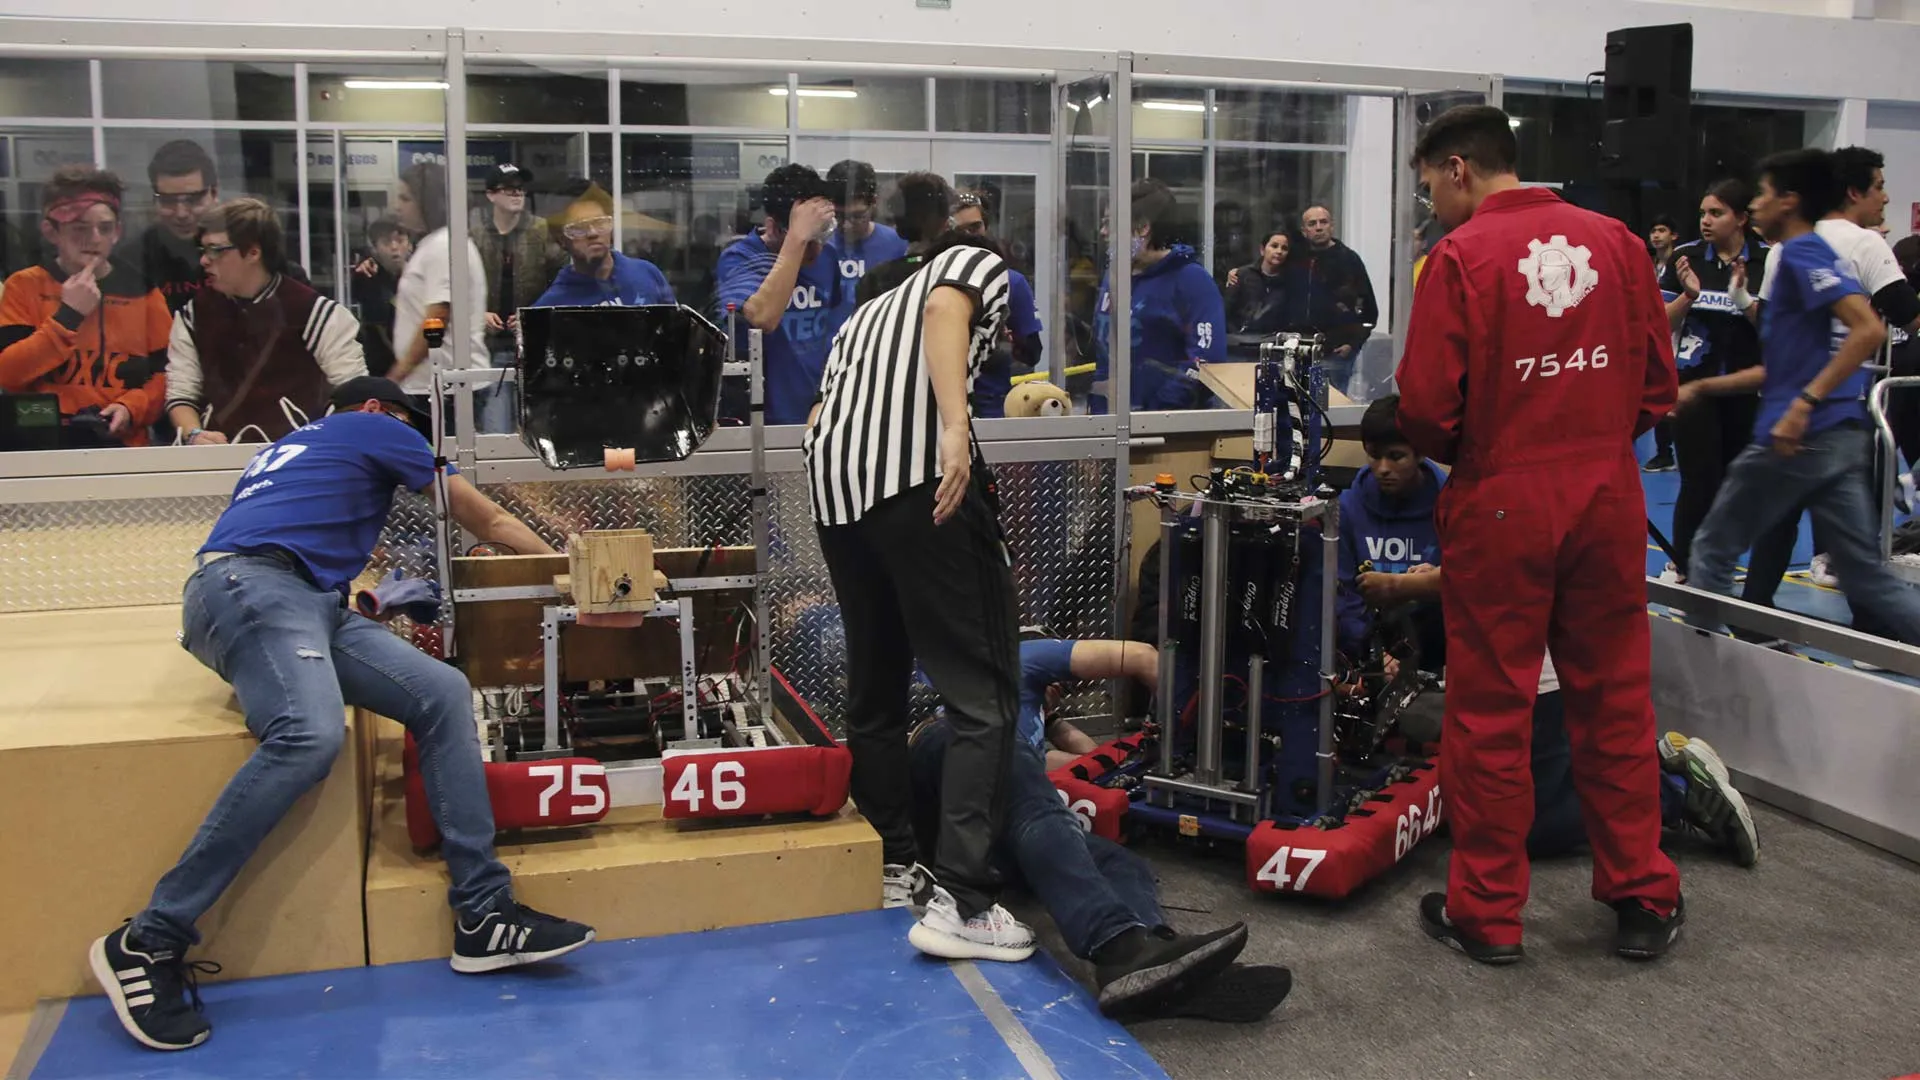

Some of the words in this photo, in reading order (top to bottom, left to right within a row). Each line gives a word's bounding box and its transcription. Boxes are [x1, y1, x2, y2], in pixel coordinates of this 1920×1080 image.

[1196, 322, 1213, 337] 66
[1197, 337, 1213, 349] 47
[1515, 344, 1609, 382] 7546
[528, 764, 605, 817] 75
[670, 760, 747, 813] 46
[1256, 845, 1328, 891] 47
